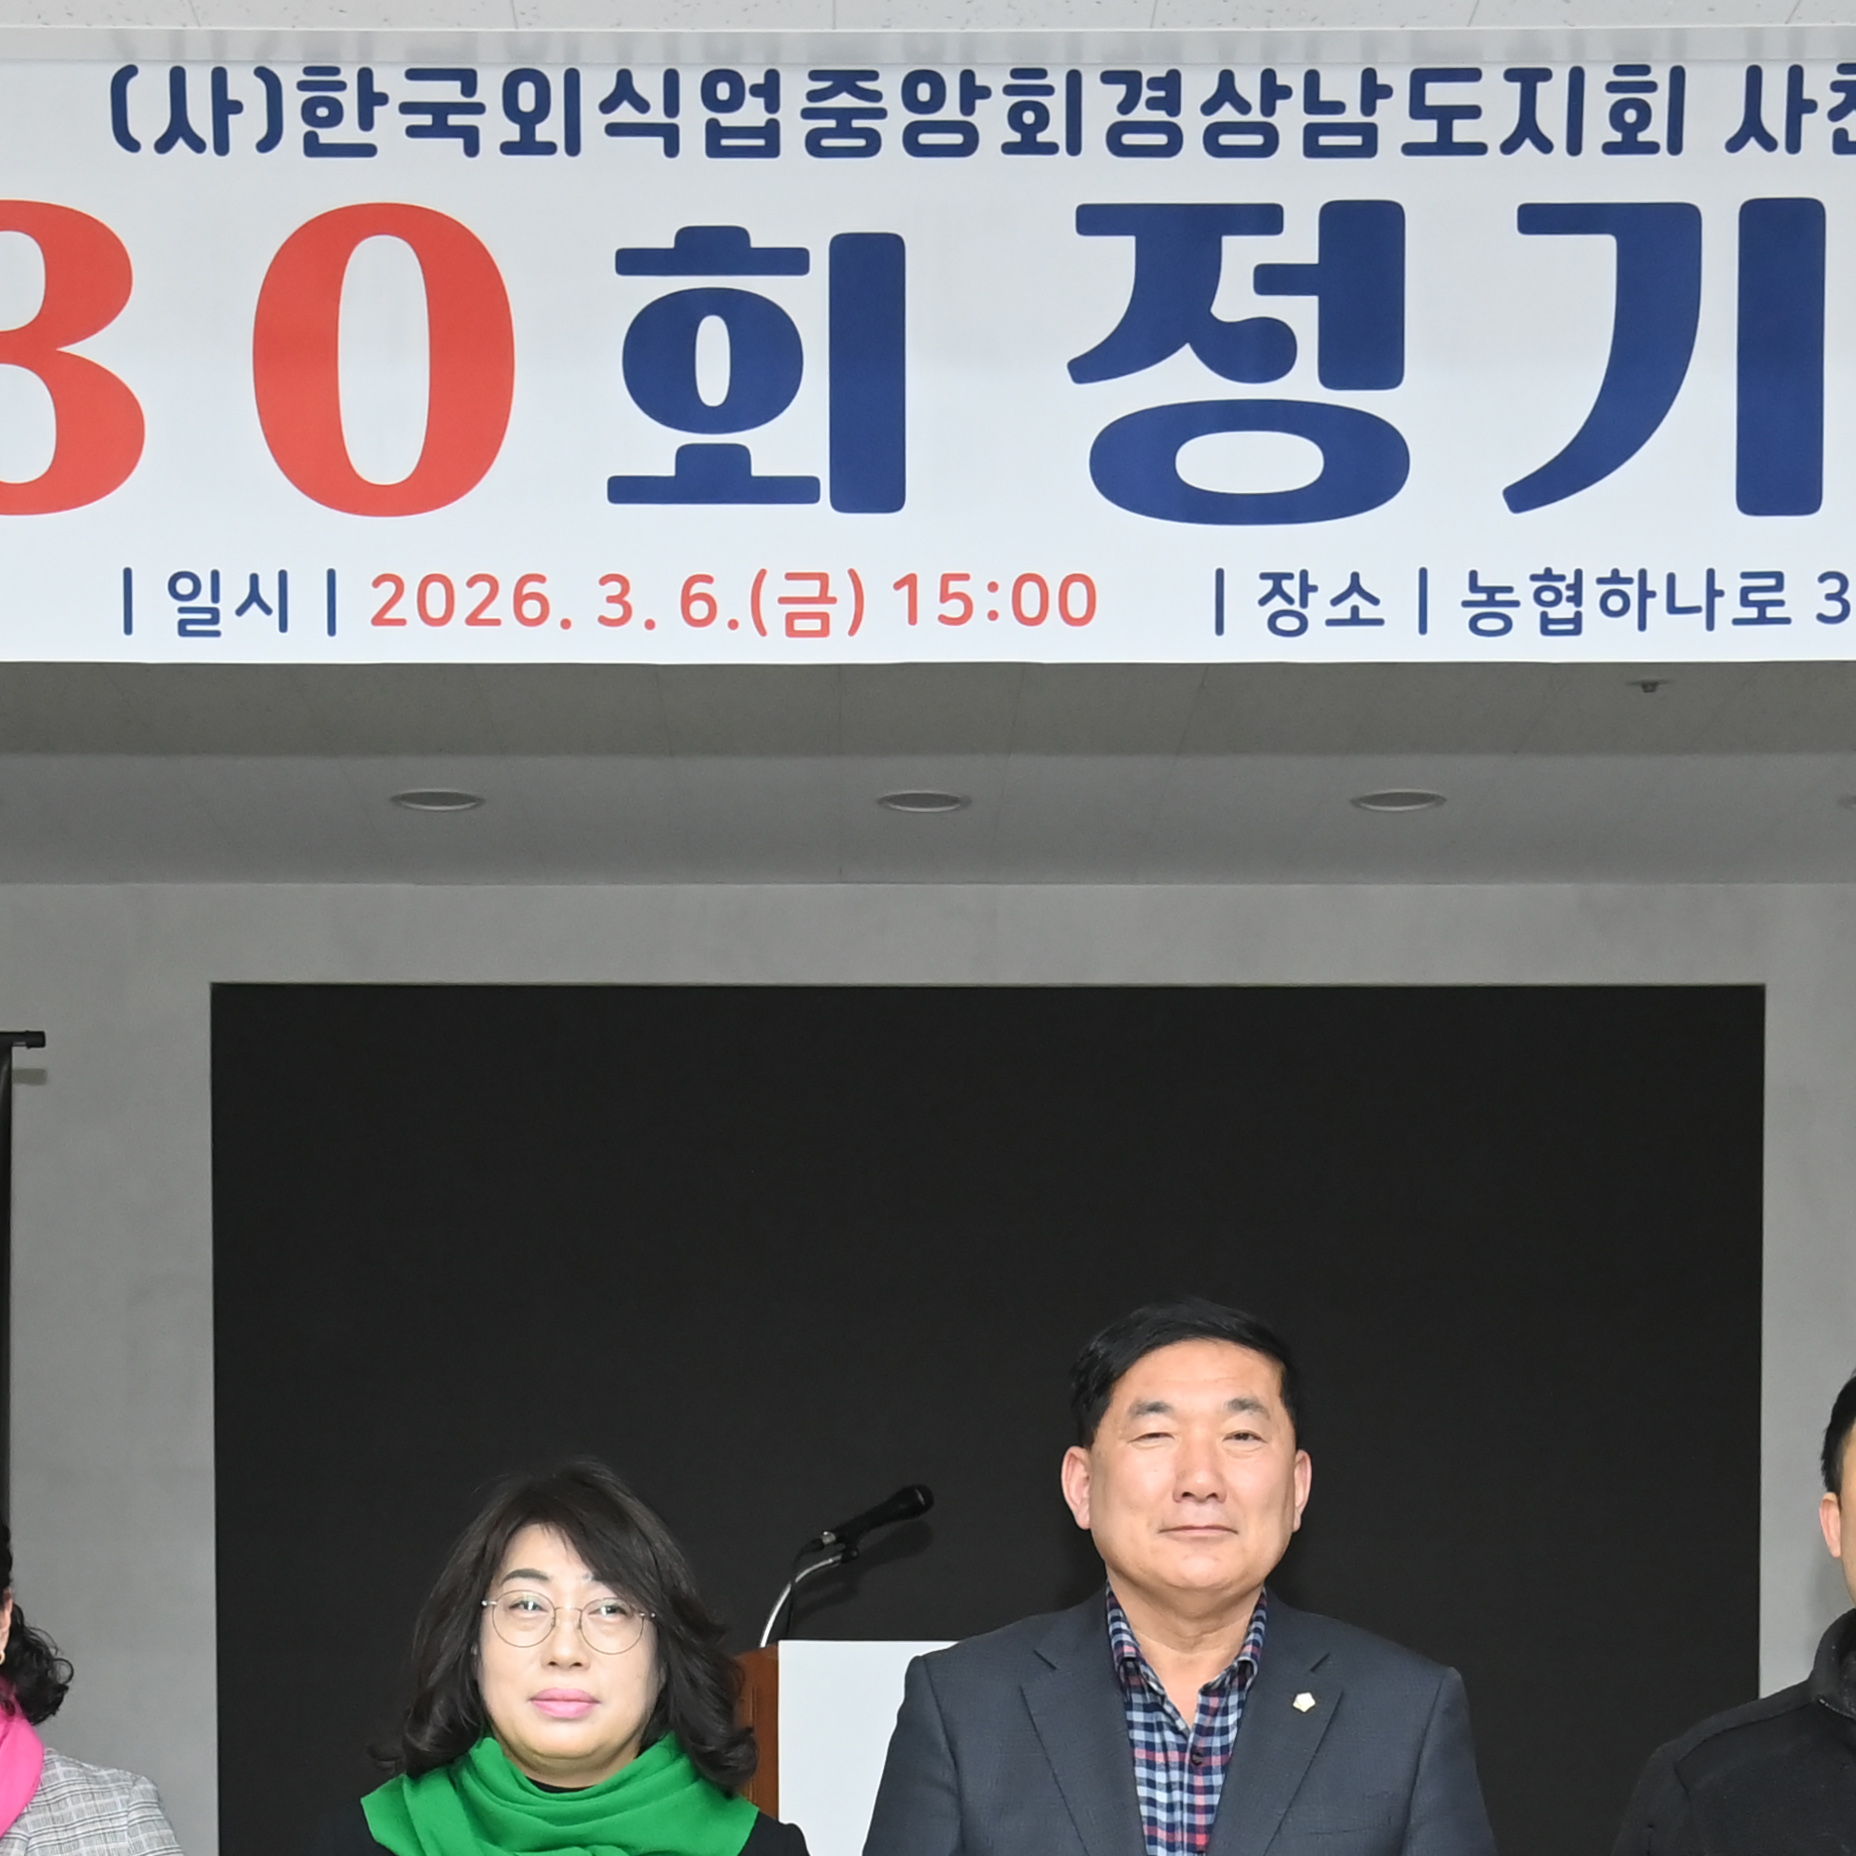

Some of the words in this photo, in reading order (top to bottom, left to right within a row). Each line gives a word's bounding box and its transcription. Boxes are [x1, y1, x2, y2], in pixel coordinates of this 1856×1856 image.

[110, 63, 1688, 161] (사)한국외식업중앙회경상남도지회
[894, 573, 1098, 631] 15:00
[1461, 567, 1793, 639] 농협하나로
